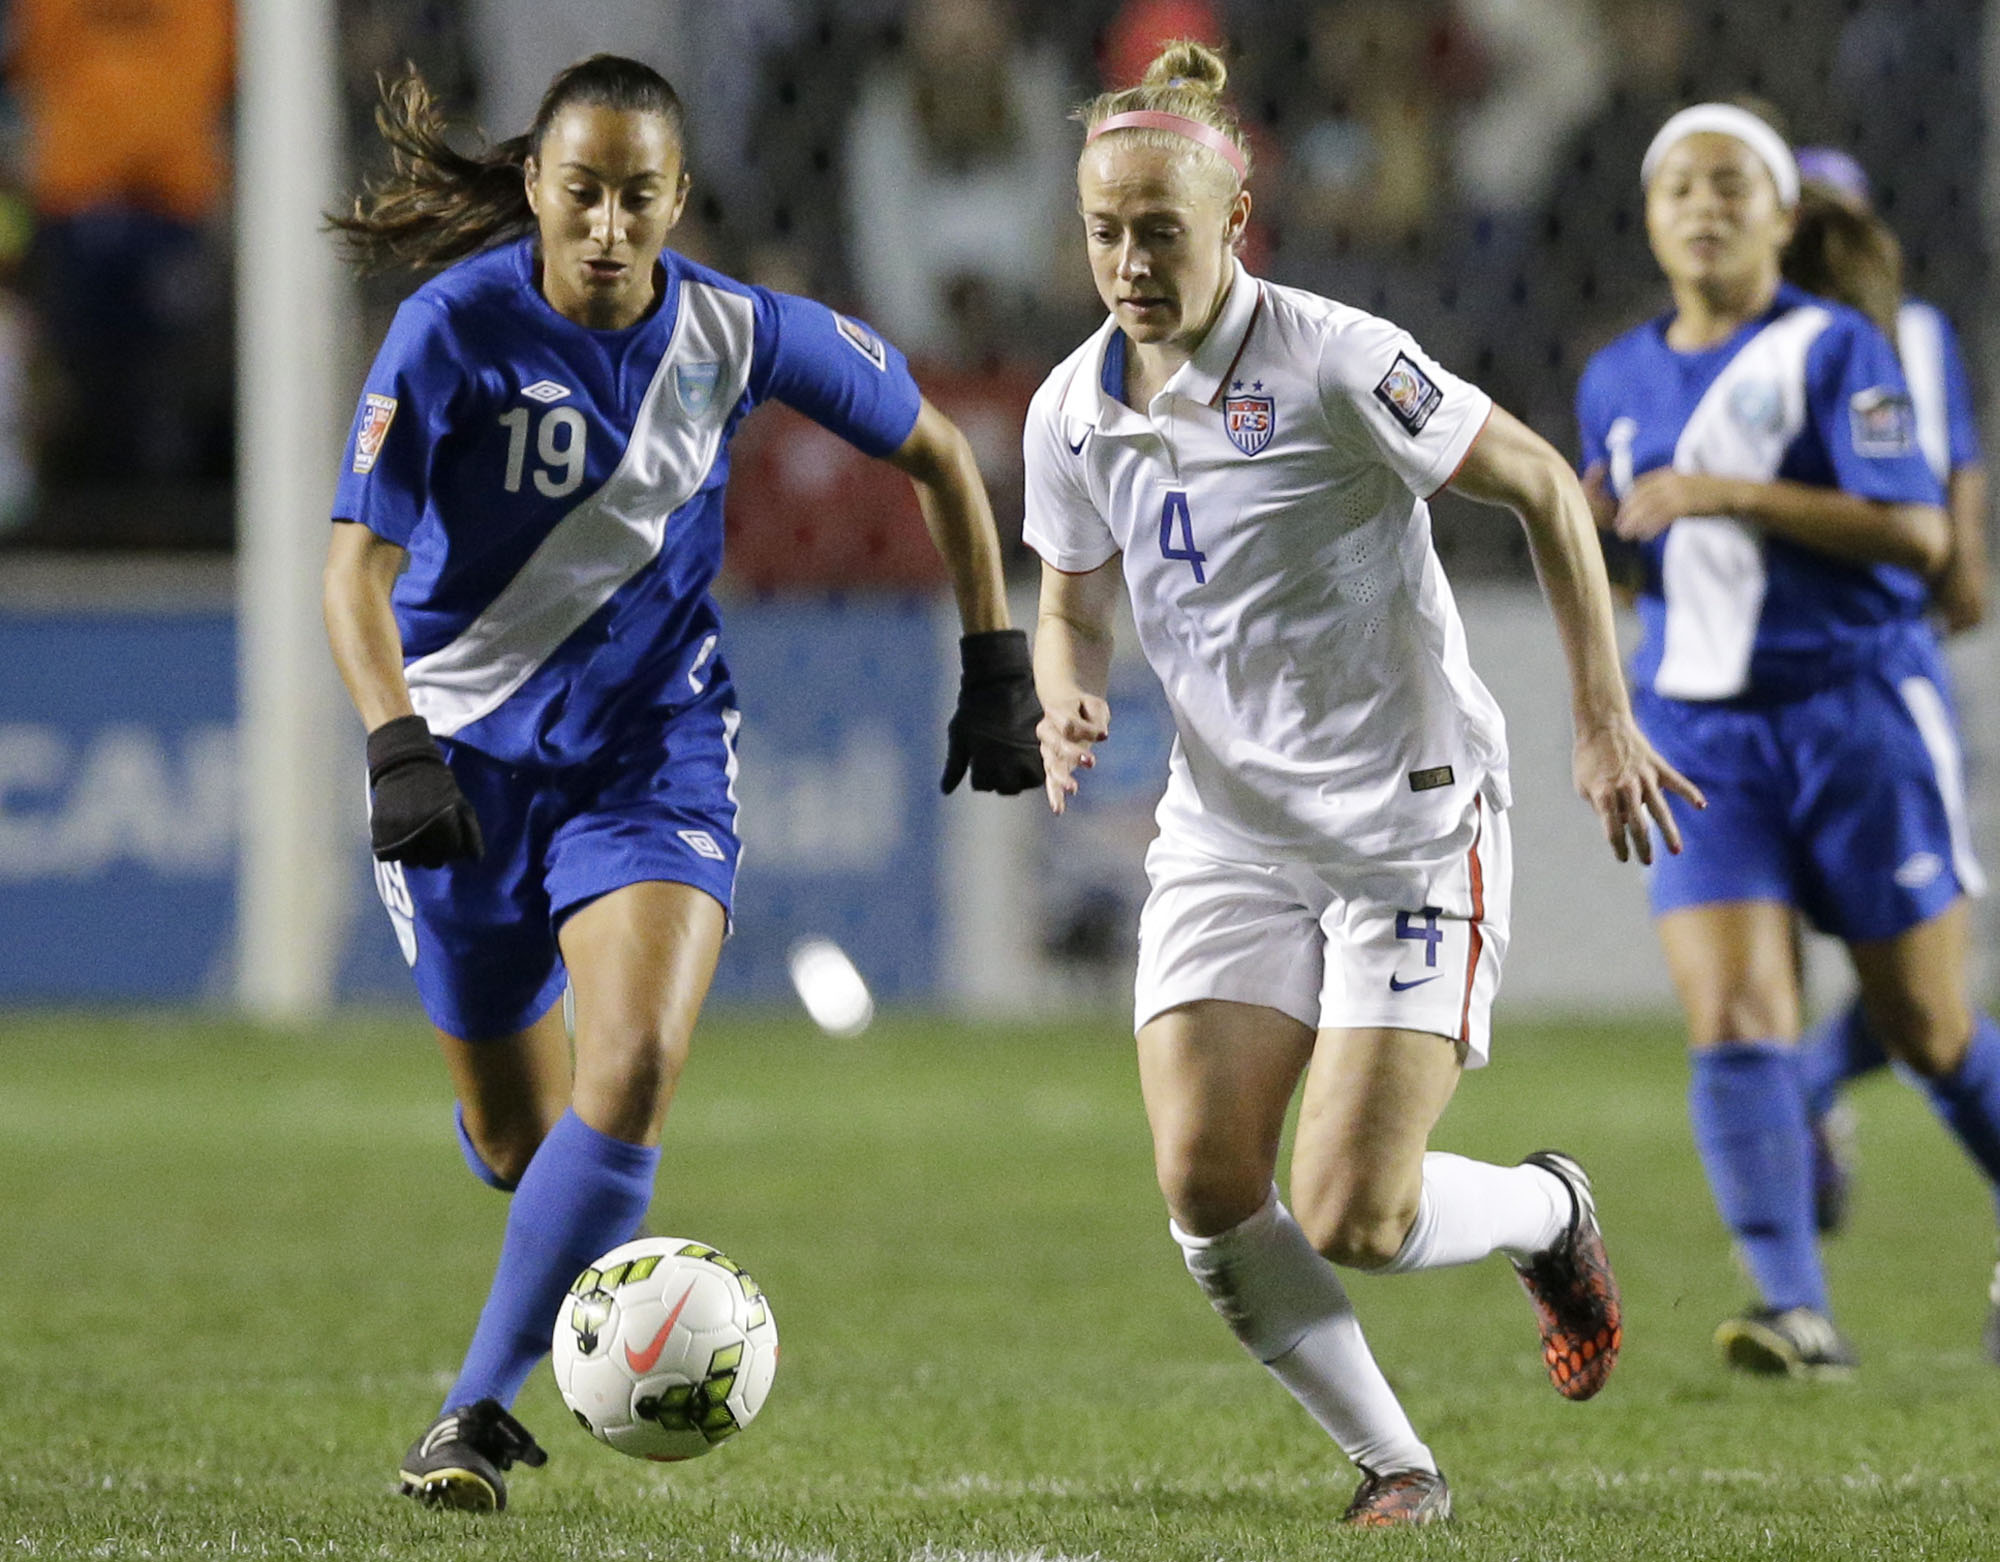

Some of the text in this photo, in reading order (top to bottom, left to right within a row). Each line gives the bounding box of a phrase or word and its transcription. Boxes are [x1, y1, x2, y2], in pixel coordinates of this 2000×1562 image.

[498, 406, 587, 497] 19
[1159, 491, 1207, 584] 4
[1396, 907, 1443, 967] 4
